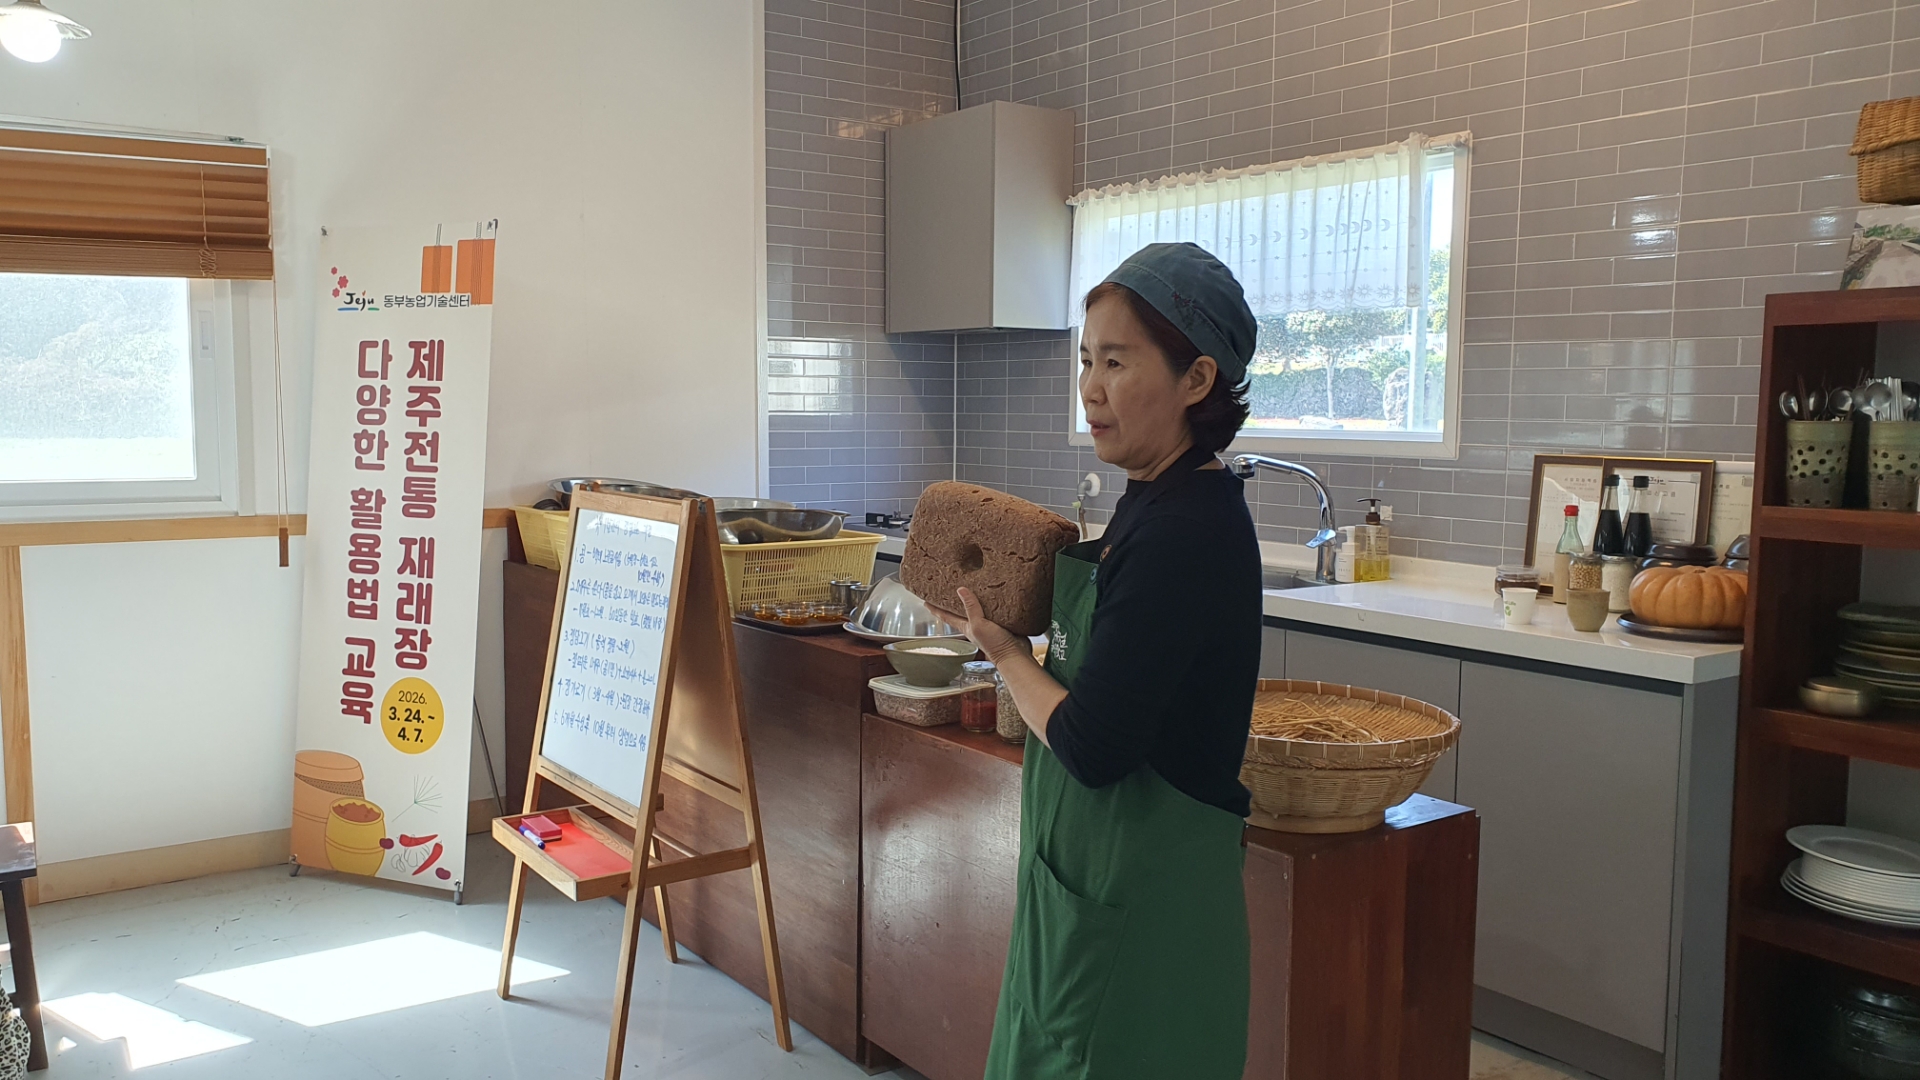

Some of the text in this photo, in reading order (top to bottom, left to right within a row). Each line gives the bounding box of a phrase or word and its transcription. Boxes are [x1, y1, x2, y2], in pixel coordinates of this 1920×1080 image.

[343, 290, 375, 311] Jeju
[383, 294, 471, 308] 동부농업기술센터
[394, 339, 445, 671] 제주전통 재래장
[340, 339, 393, 725] 다양한 활용법 교육
[398, 690, 428, 706] 2026.
